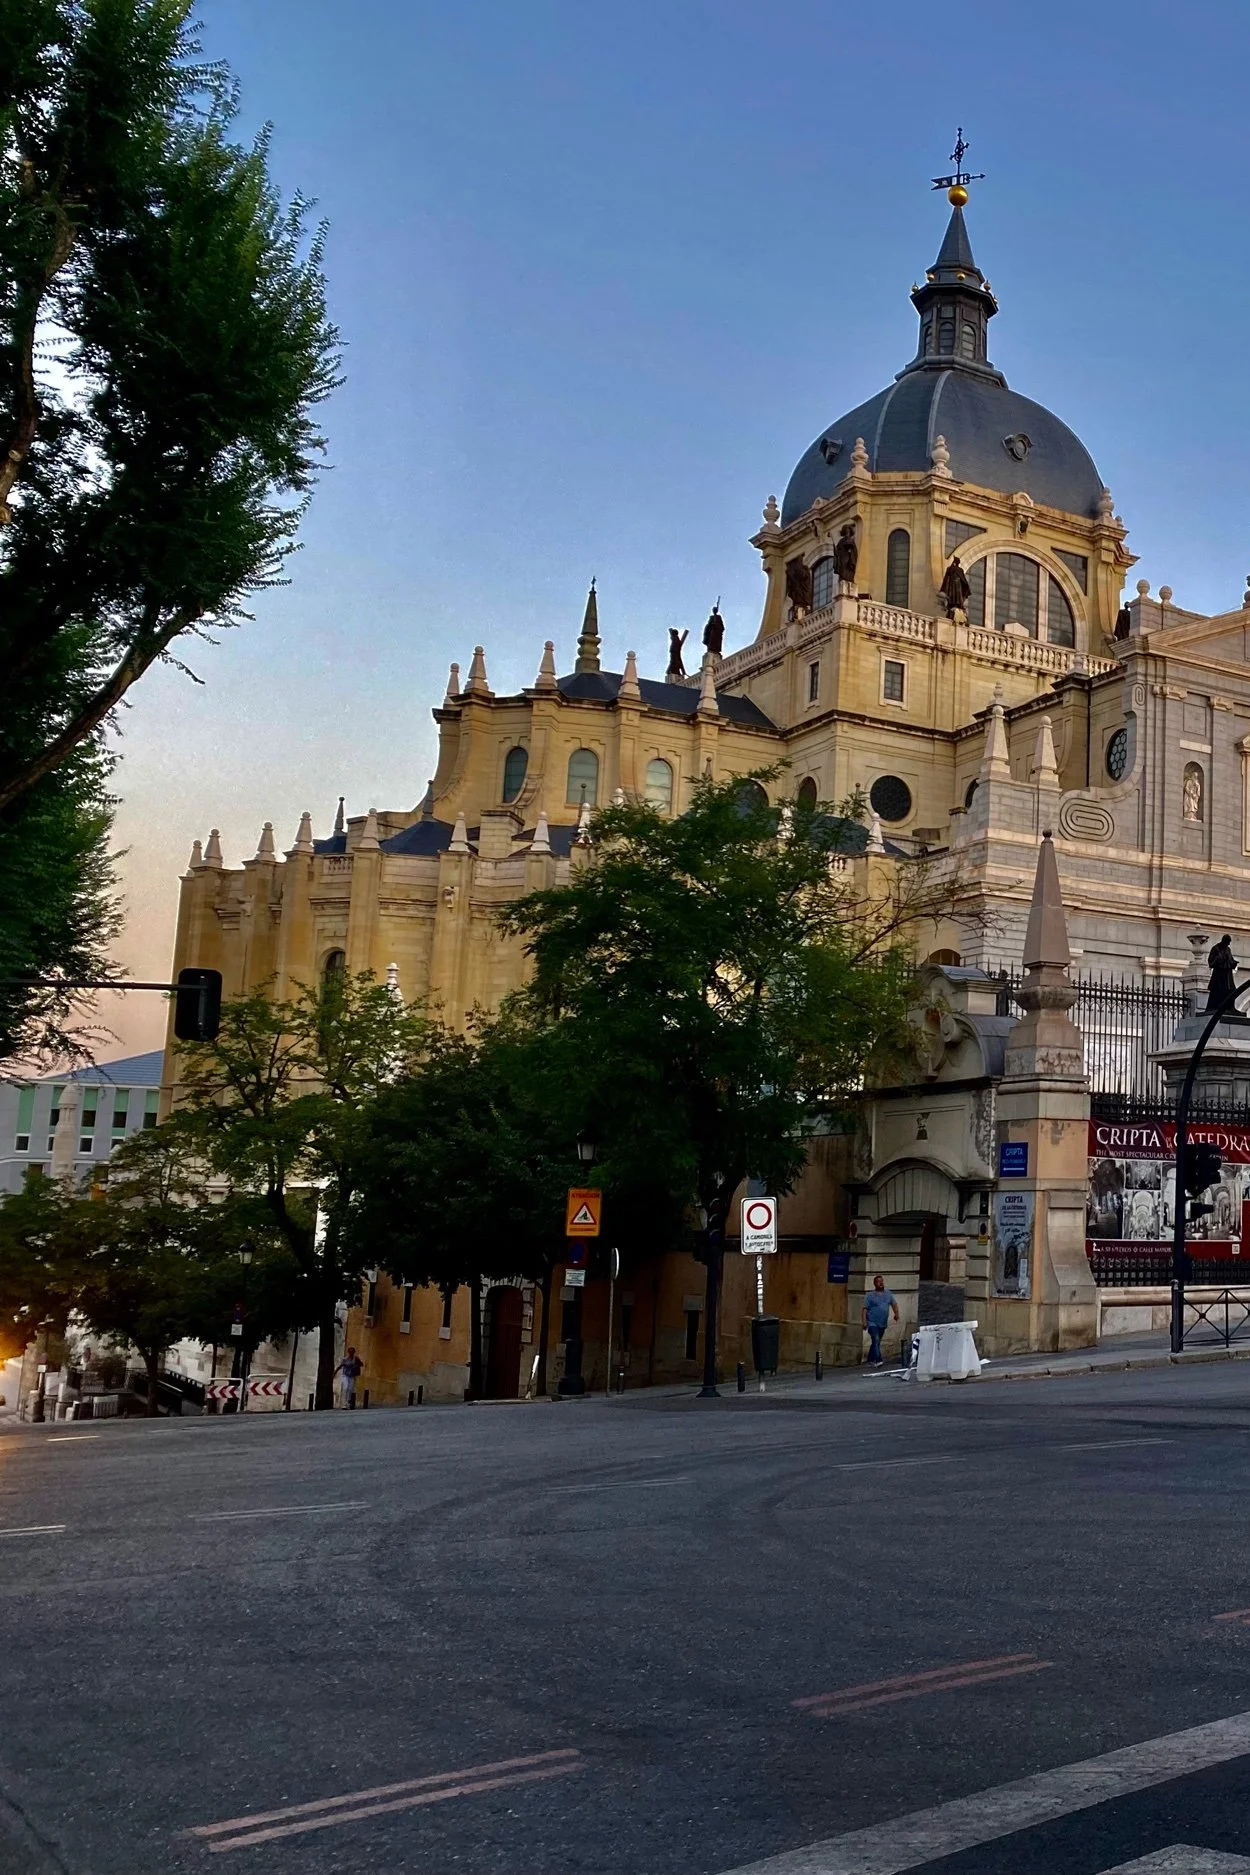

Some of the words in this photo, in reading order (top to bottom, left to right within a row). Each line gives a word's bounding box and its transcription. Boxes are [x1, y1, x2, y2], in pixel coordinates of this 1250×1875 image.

[1096, 1127, 1161, 1147] CRIPTA
[1126, 1151, 1164, 1159] SPECTACULAR
[1005, 1195, 1023, 1203] CRIPTA
